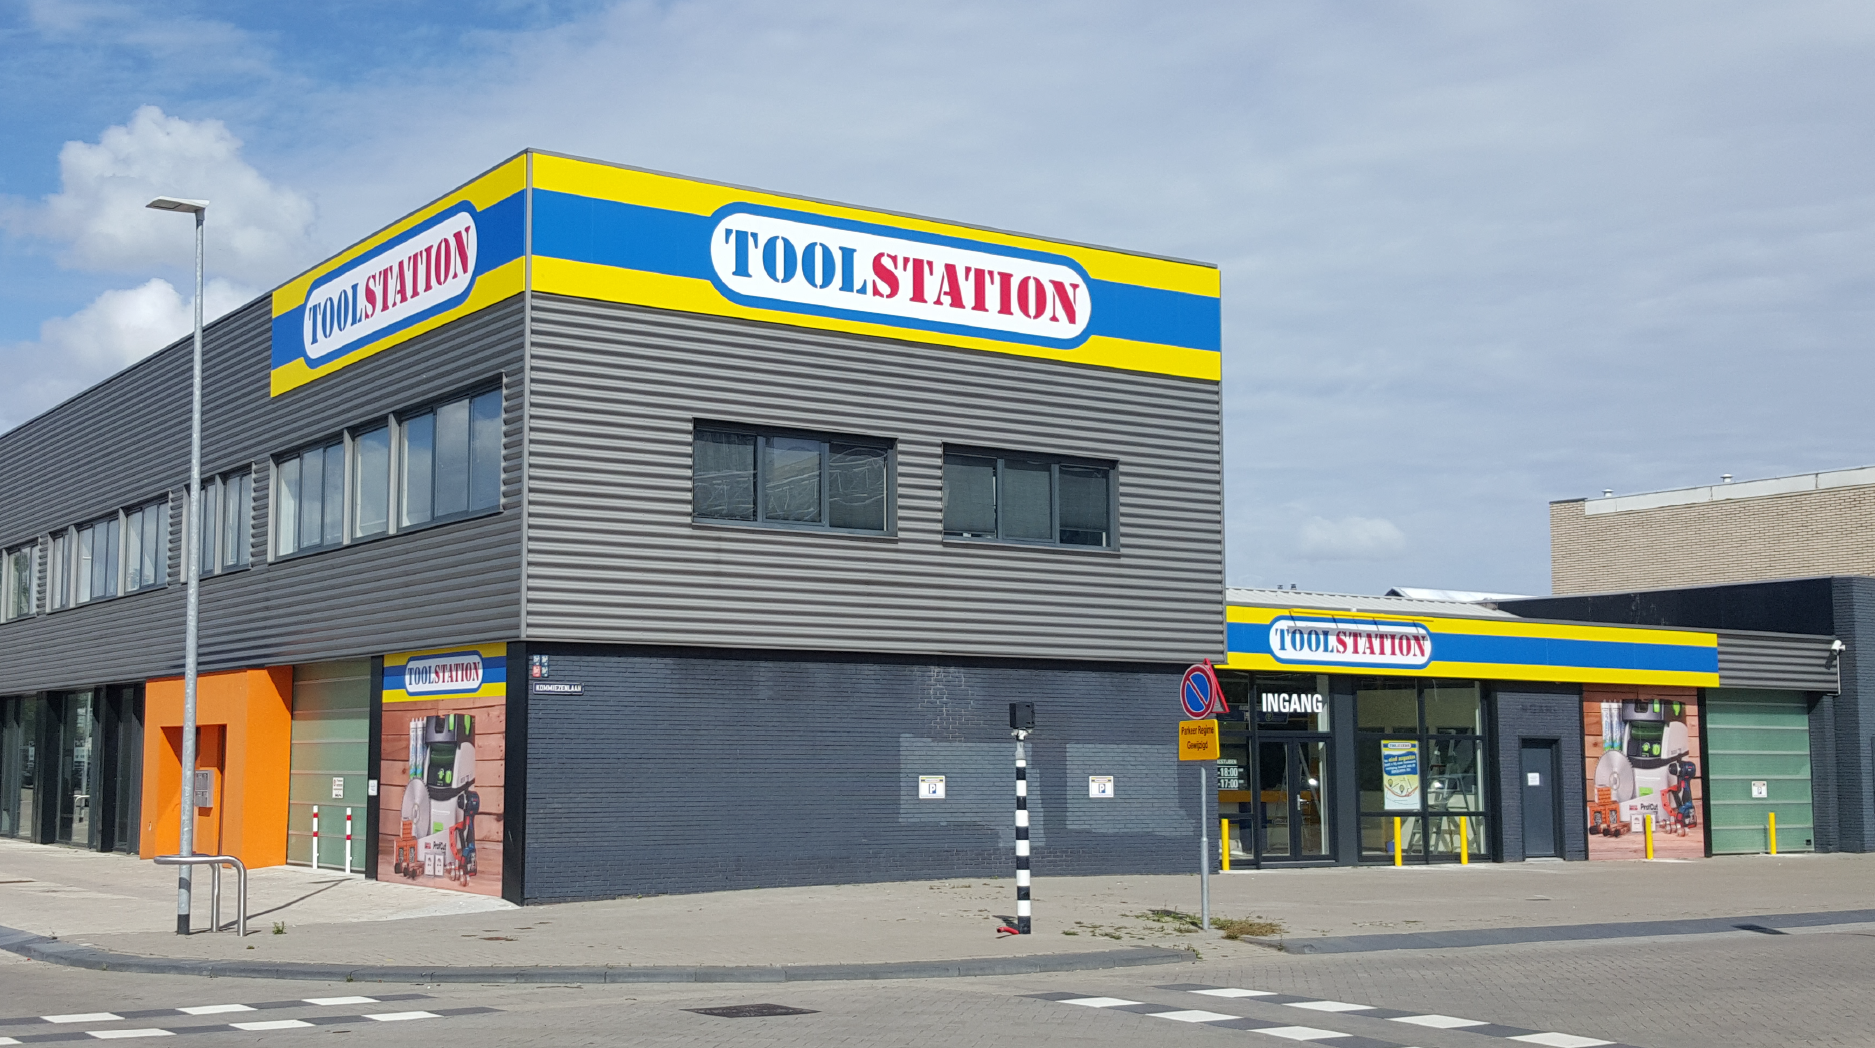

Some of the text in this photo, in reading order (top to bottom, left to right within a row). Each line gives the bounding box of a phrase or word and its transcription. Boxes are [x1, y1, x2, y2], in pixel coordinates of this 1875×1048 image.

[308, 225, 471, 345] TOOLSTATION
[725, 228, 1080, 325] TOOLSTATION
[1275, 628, 1427, 657] TOOLSTATION
[407, 661, 480, 686] TOOLSTATION
[1261, 693, 1323, 713] INGANG
[1181, 724, 1214, 736] Parkeer Regime
